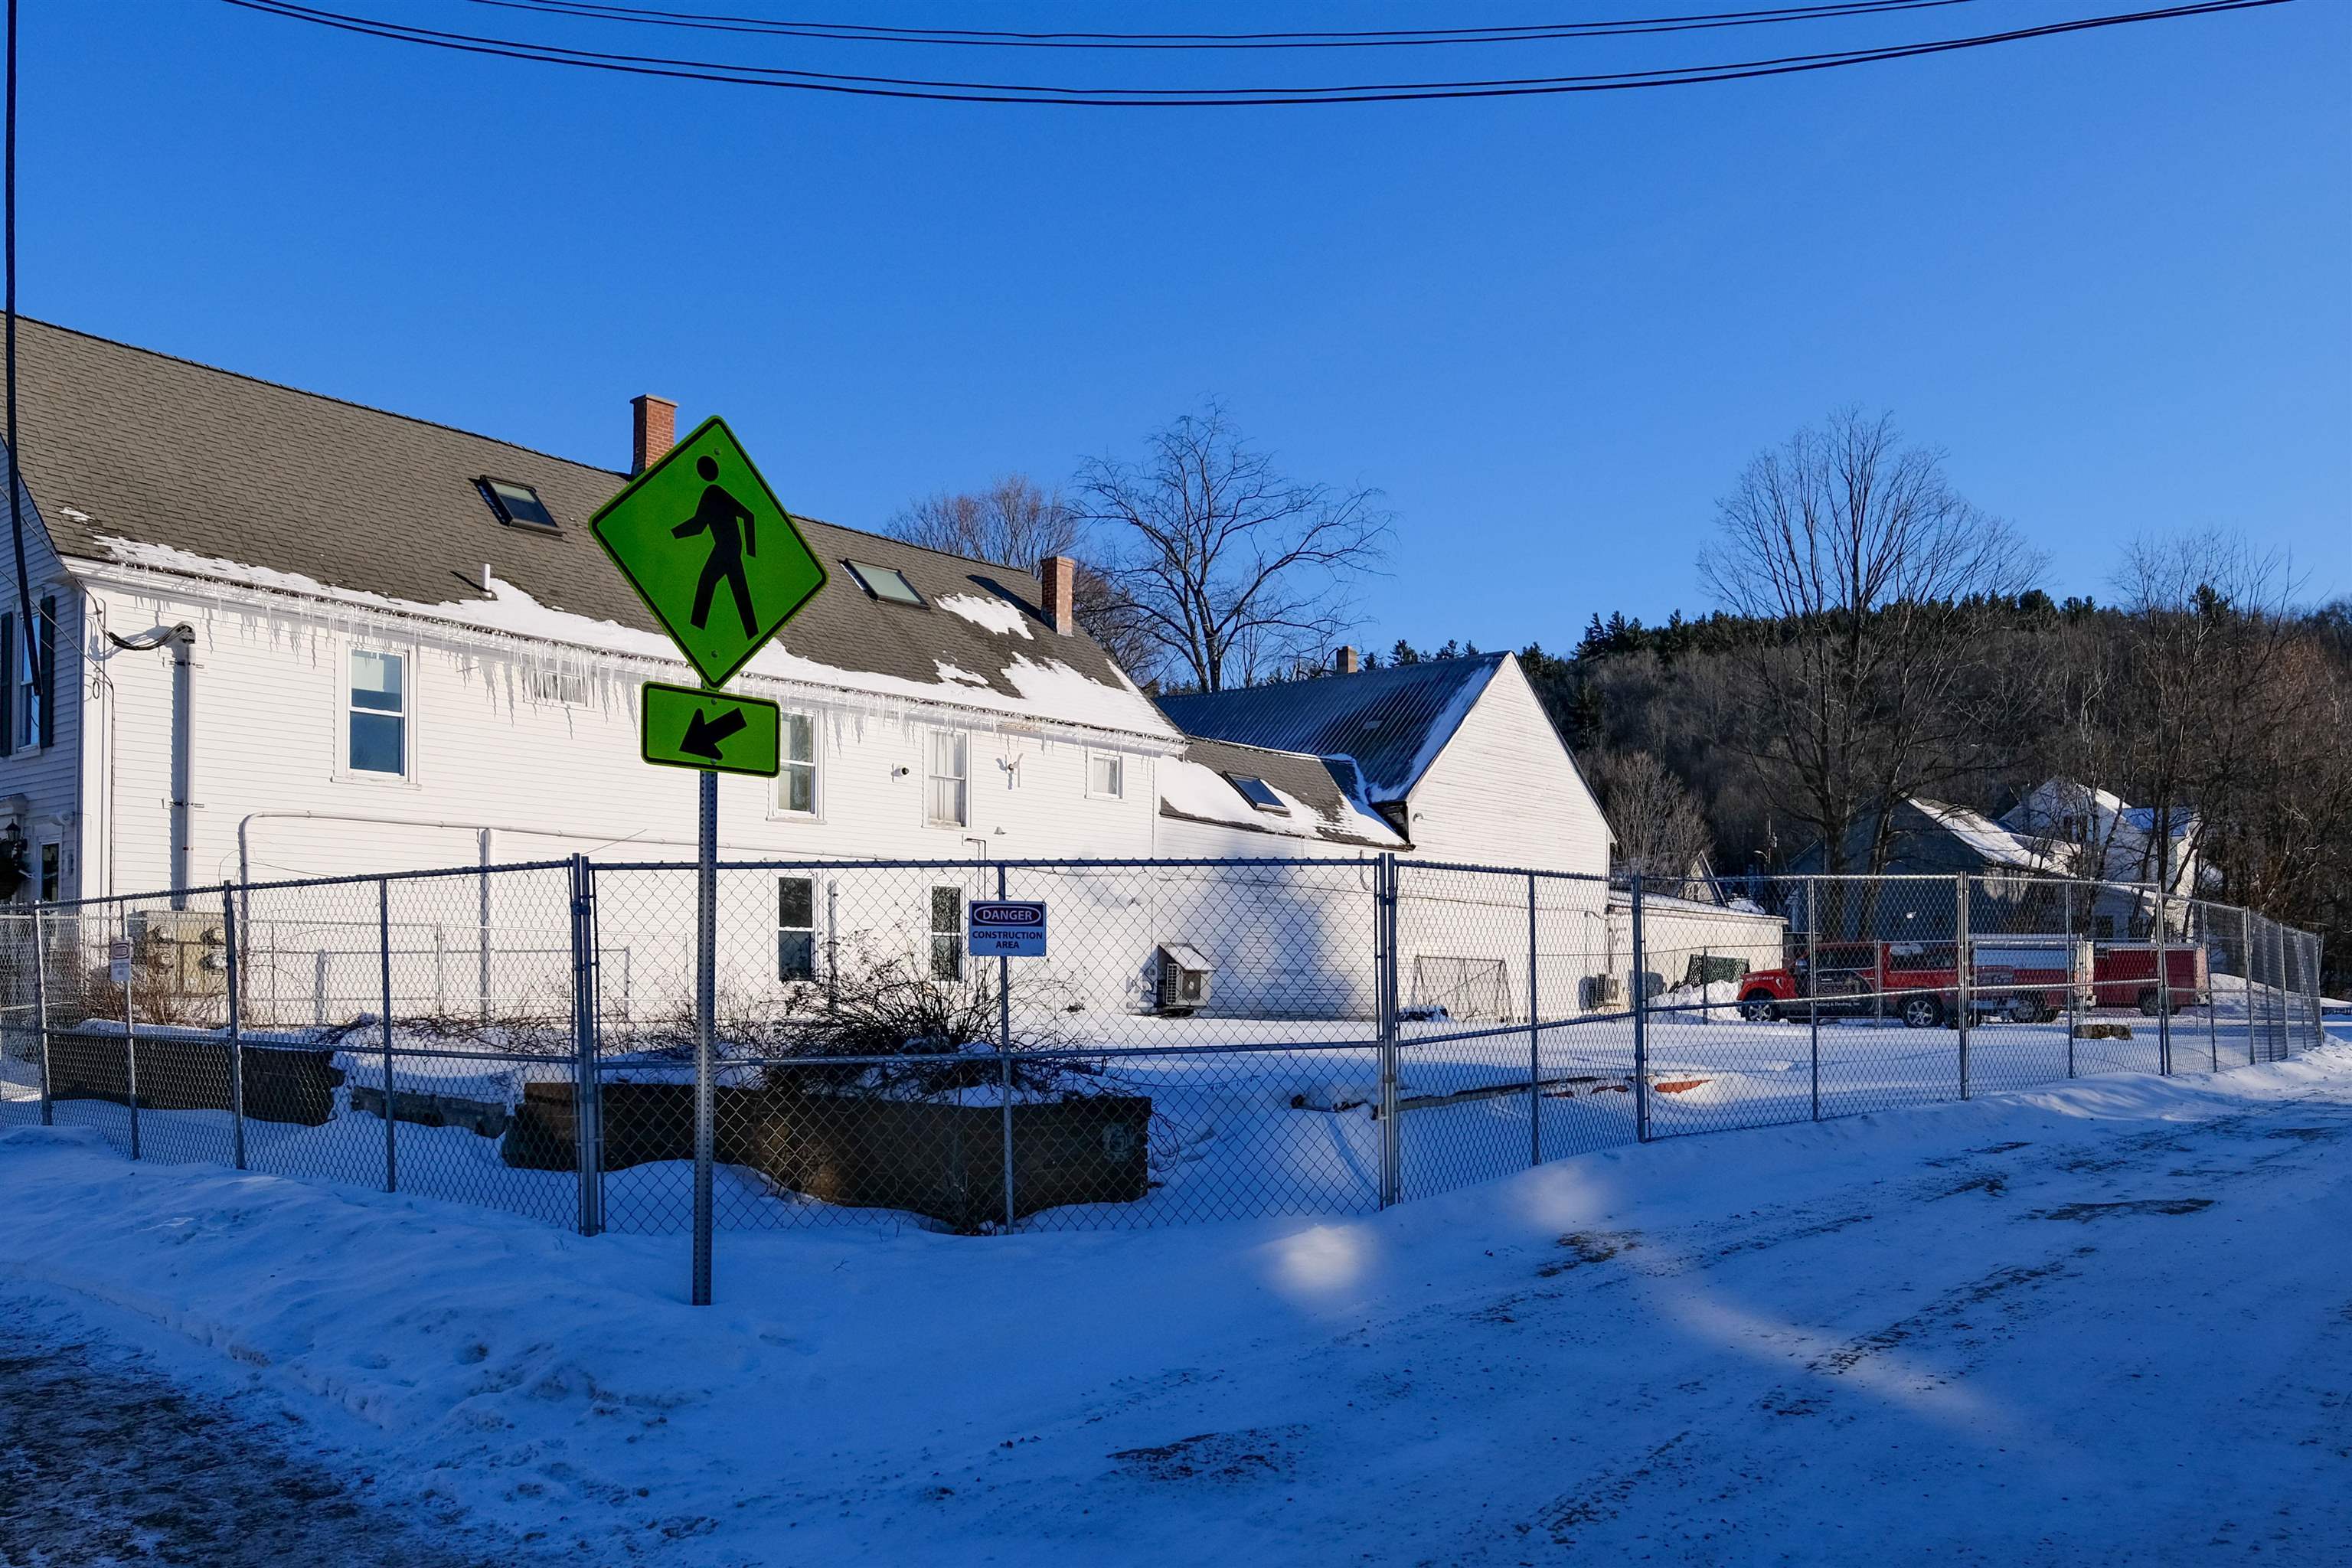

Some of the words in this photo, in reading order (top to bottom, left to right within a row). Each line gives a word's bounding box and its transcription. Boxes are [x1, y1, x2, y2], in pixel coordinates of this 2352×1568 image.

[983, 910, 1032, 920] DANGER
[972, 930, 1043, 939] CONSTRUCTION
[995, 940, 1020, 949] AREA
